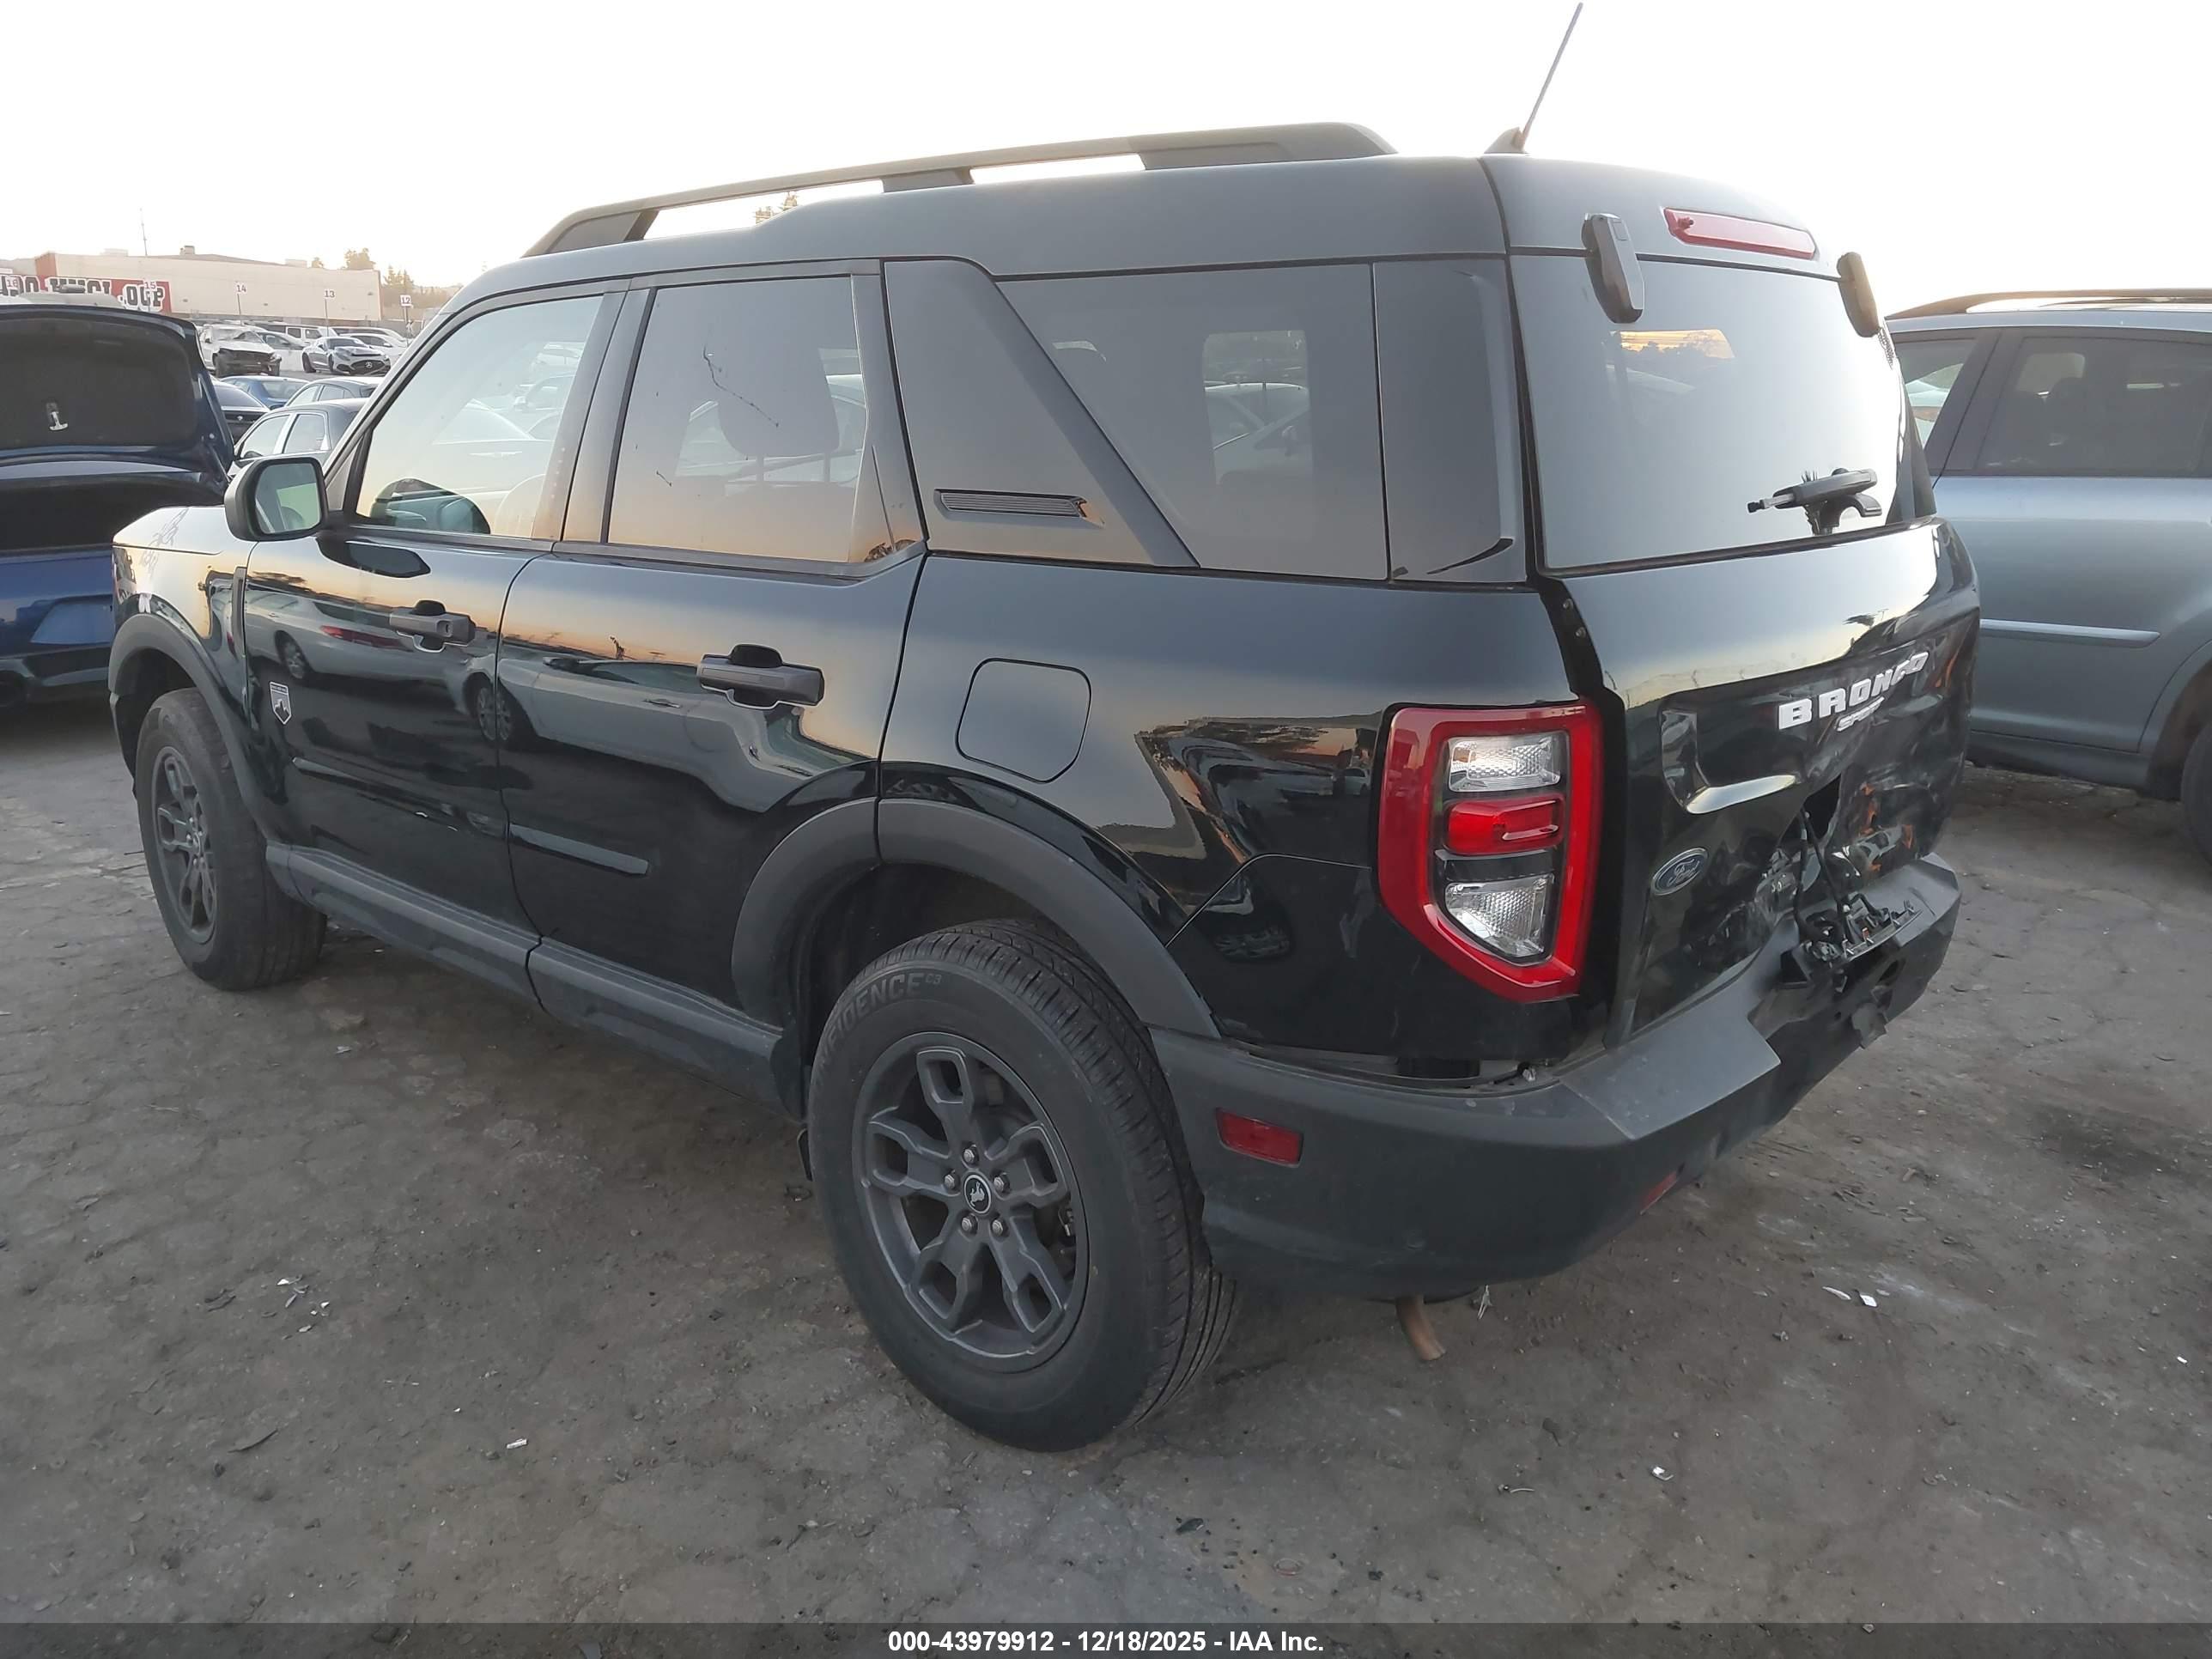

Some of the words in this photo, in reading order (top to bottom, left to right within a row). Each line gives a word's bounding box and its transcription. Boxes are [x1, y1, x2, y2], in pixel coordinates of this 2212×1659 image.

[144, 281, 156, 289] 15
[236, 284, 246, 293] 14
[401, 296, 411, 305] 12
[1778, 652, 1929, 730] BRONCO
